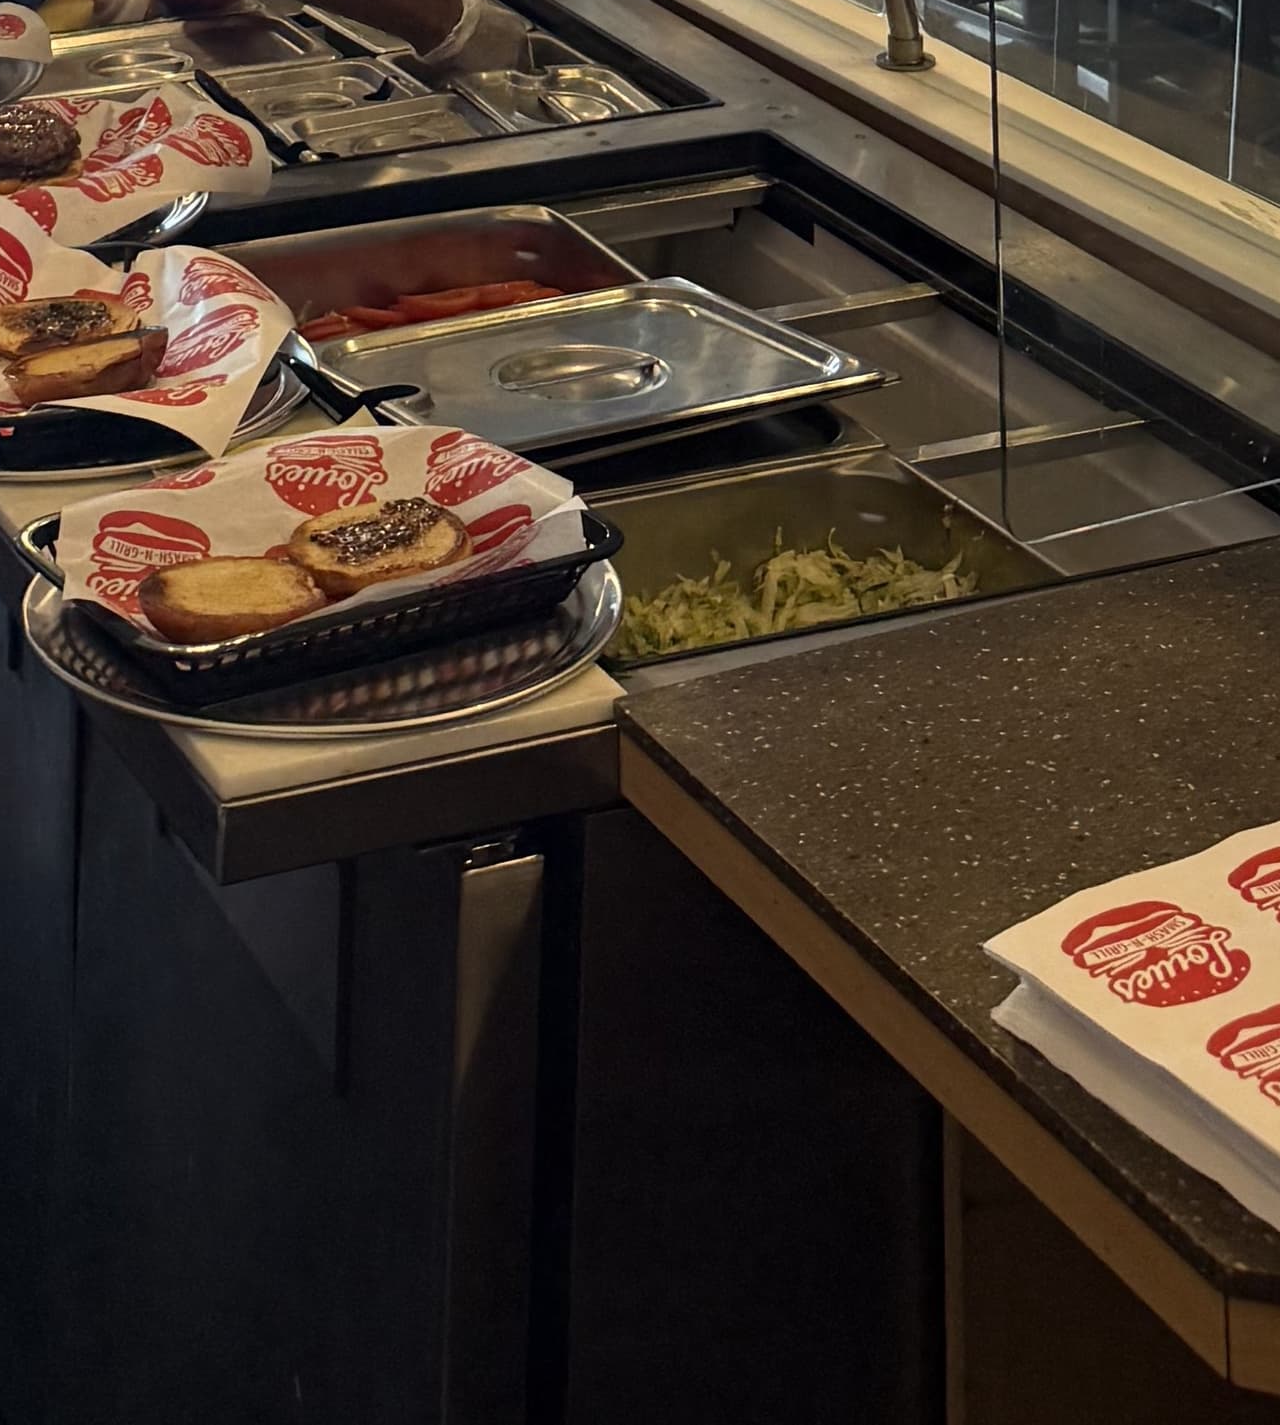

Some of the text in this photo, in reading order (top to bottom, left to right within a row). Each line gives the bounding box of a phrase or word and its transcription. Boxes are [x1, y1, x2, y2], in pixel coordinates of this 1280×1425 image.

[266, 460, 389, 510] Louie's
[1091, 915, 1187, 961] SMASH-N-GRILL
[1113, 926, 1232, 1001] Louie's
